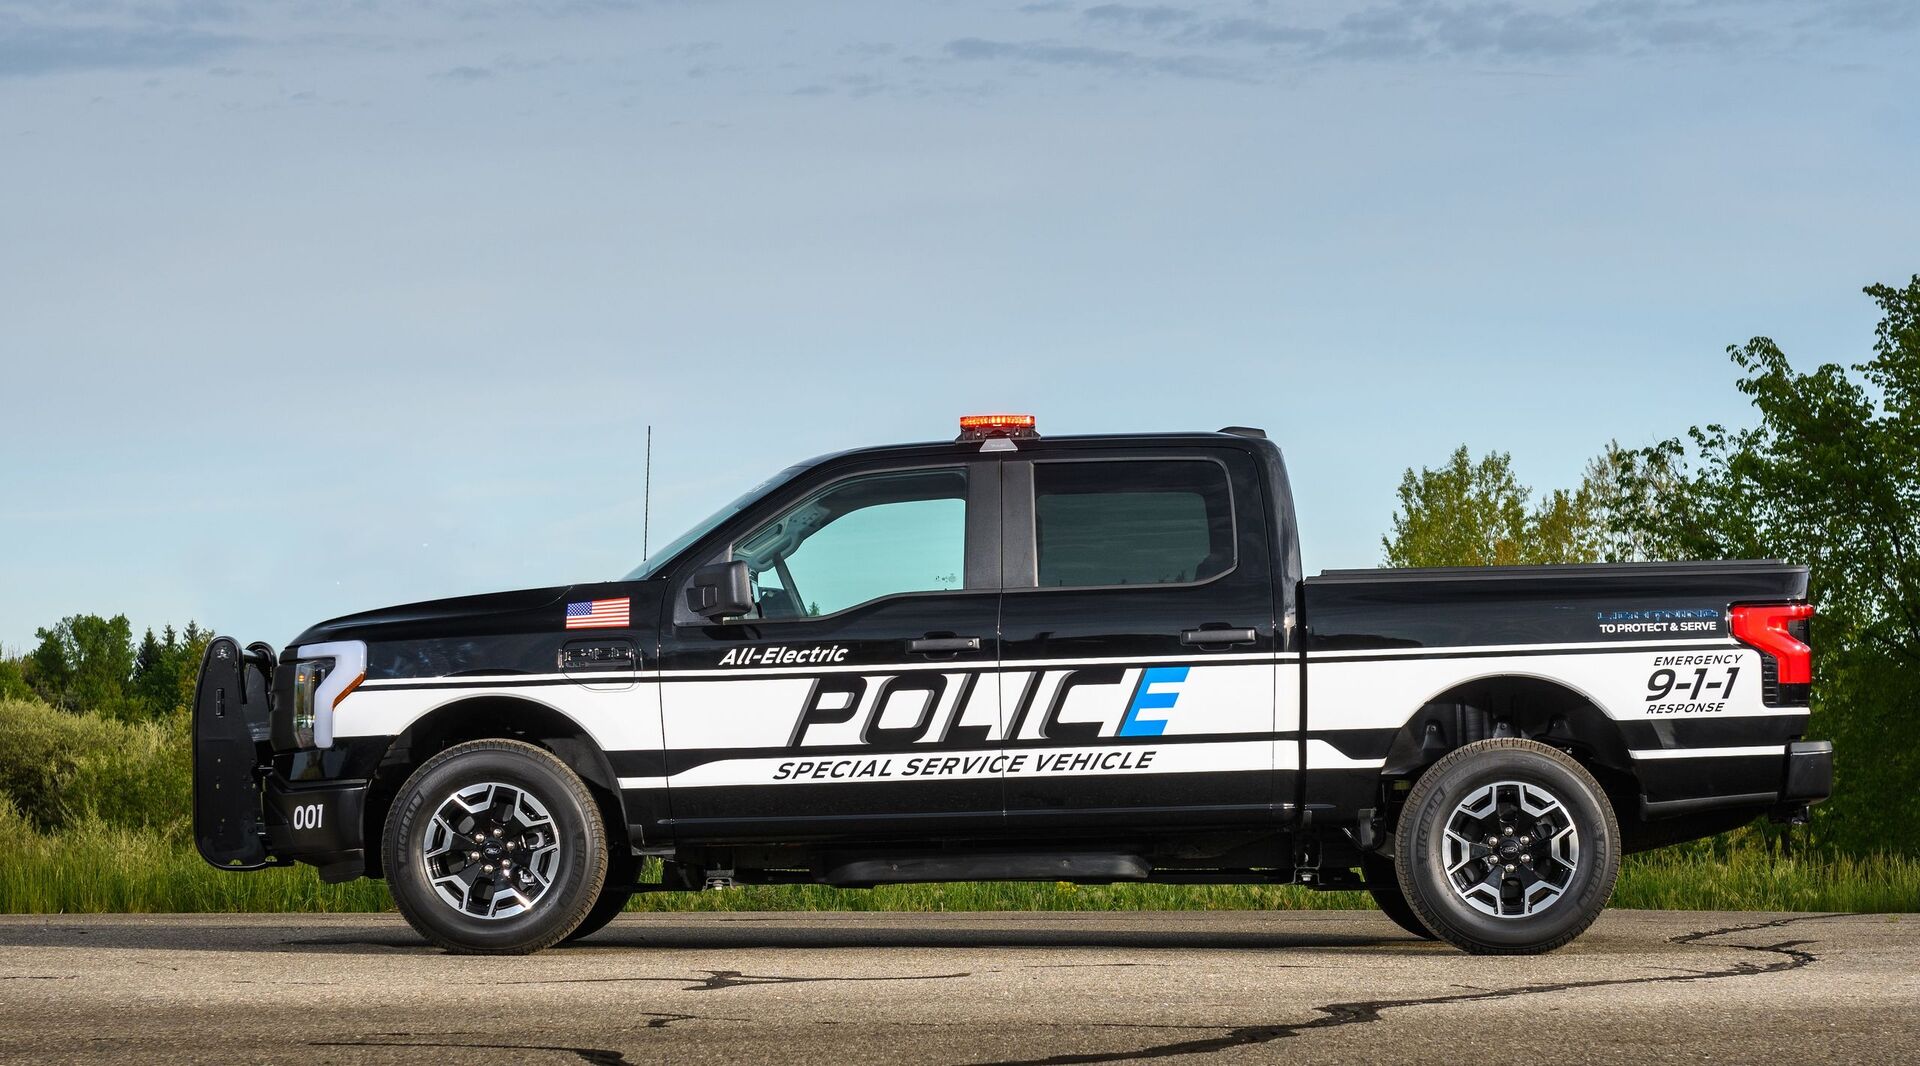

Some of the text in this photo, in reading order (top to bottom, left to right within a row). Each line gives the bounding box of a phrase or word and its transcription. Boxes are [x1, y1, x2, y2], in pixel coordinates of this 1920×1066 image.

[1599, 621, 1716, 633] TO PROTECT & SERVE
[719, 645, 848, 666] All-Electric
[1653, 654, 1743, 666] EMERGENCY
[1645, 667, 1740, 701] 9-1-1
[786, 666, 1191, 748] POLICE
[1646, 702, 1725, 714] RESPONSE
[773, 751, 1156, 780] SPECIAL SERVICE VEHICLE
[294, 804, 323, 830] 001
